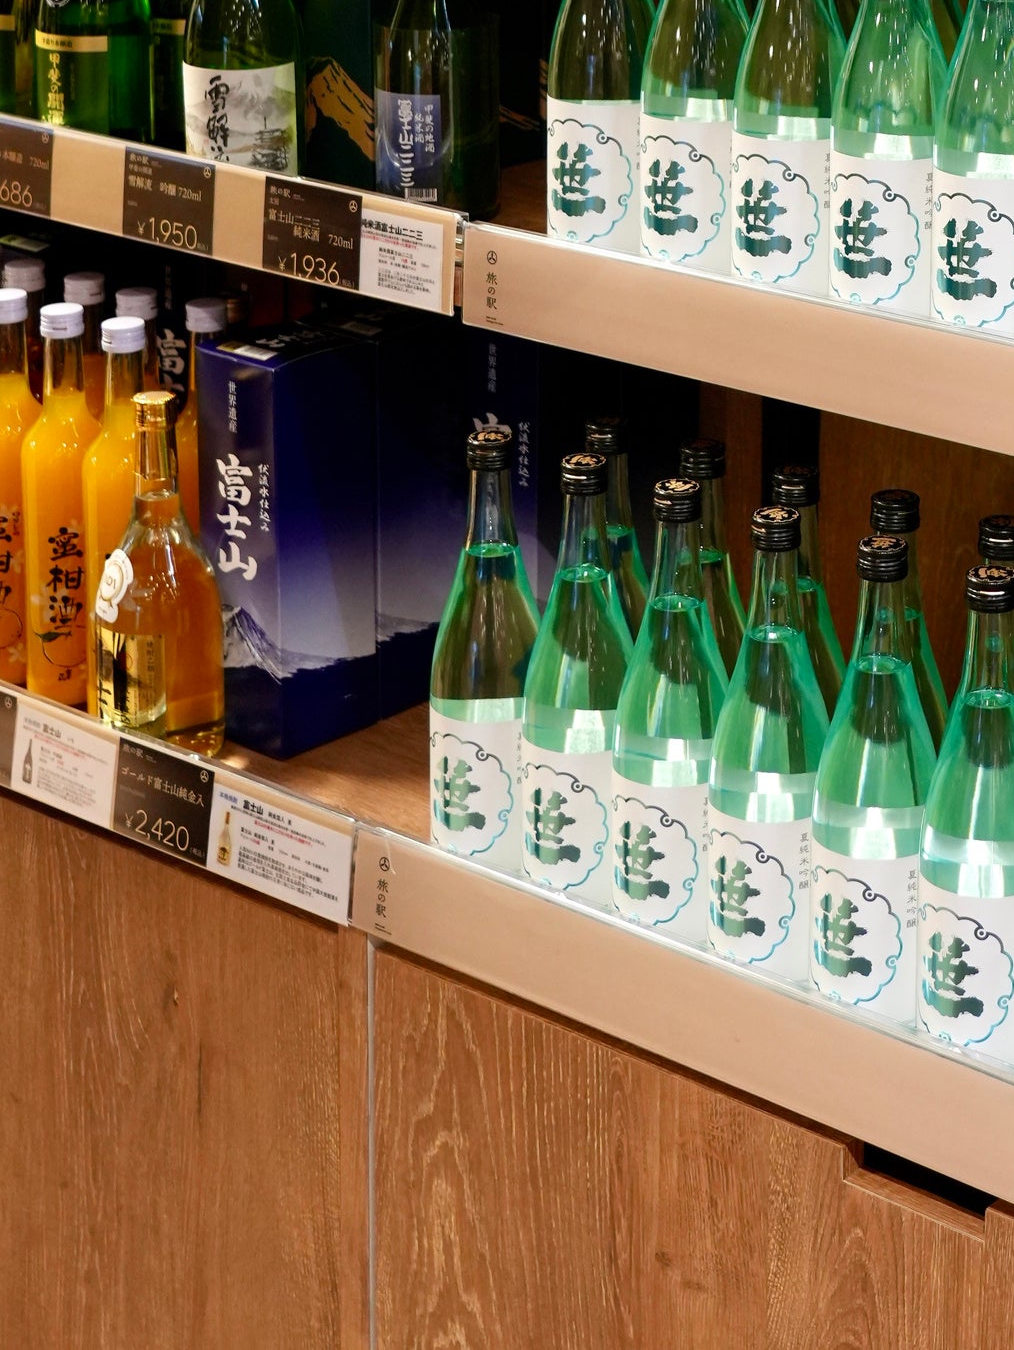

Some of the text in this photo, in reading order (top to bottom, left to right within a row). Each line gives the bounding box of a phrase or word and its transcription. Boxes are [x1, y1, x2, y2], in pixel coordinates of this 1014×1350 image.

[424, 104, 435, 153] 甲斐の地酒
[29, 157, 50, 171] 720ml
[178, 186, 202, 202] 720ml
[924, 172, 934, 230] 夏純米吟醸
[137, 217, 197, 250] ¥1,950
[293, 225, 320, 243] 純米酒
[328, 234, 354, 250] 720ml
[277, 252, 340, 286] ¥1,936
[486, 272, 498, 310] 旅の駅
[216, 453, 258, 581] 富士山
[257, 463, 271, 532] 伏流水仕込み
[121, 766, 205, 808] ゴールド富士山純金入
[243, 799, 264, 816] 富士山
[125, 809, 190, 852] ¥2,420
[799, 831, 811, 891] 夏純米吟醸
[375, 878, 389, 919] 旅の駅
[906, 868, 918, 929] 夏純米吟醸
